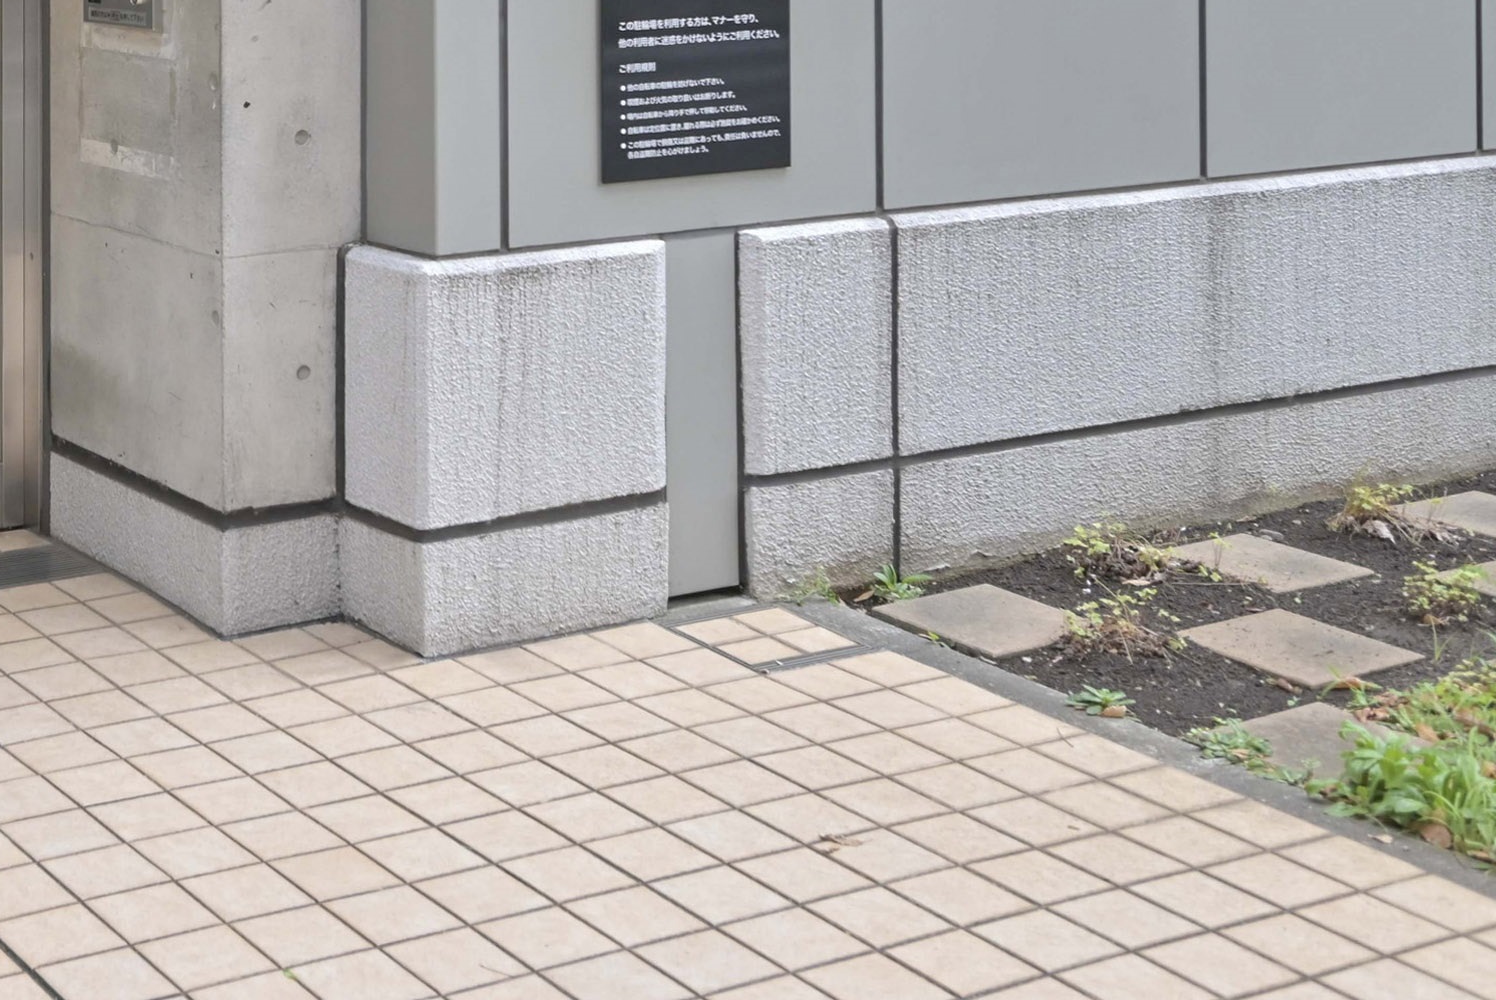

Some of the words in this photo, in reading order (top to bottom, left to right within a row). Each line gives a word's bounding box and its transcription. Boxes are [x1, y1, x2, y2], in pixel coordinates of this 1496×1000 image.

[618, 14, 759, 31] この駐輪場を利用する方は、マナーを守り、
[618, 29, 780, 48] 他の利用者に迷惑をかけないようにご利用ください。
